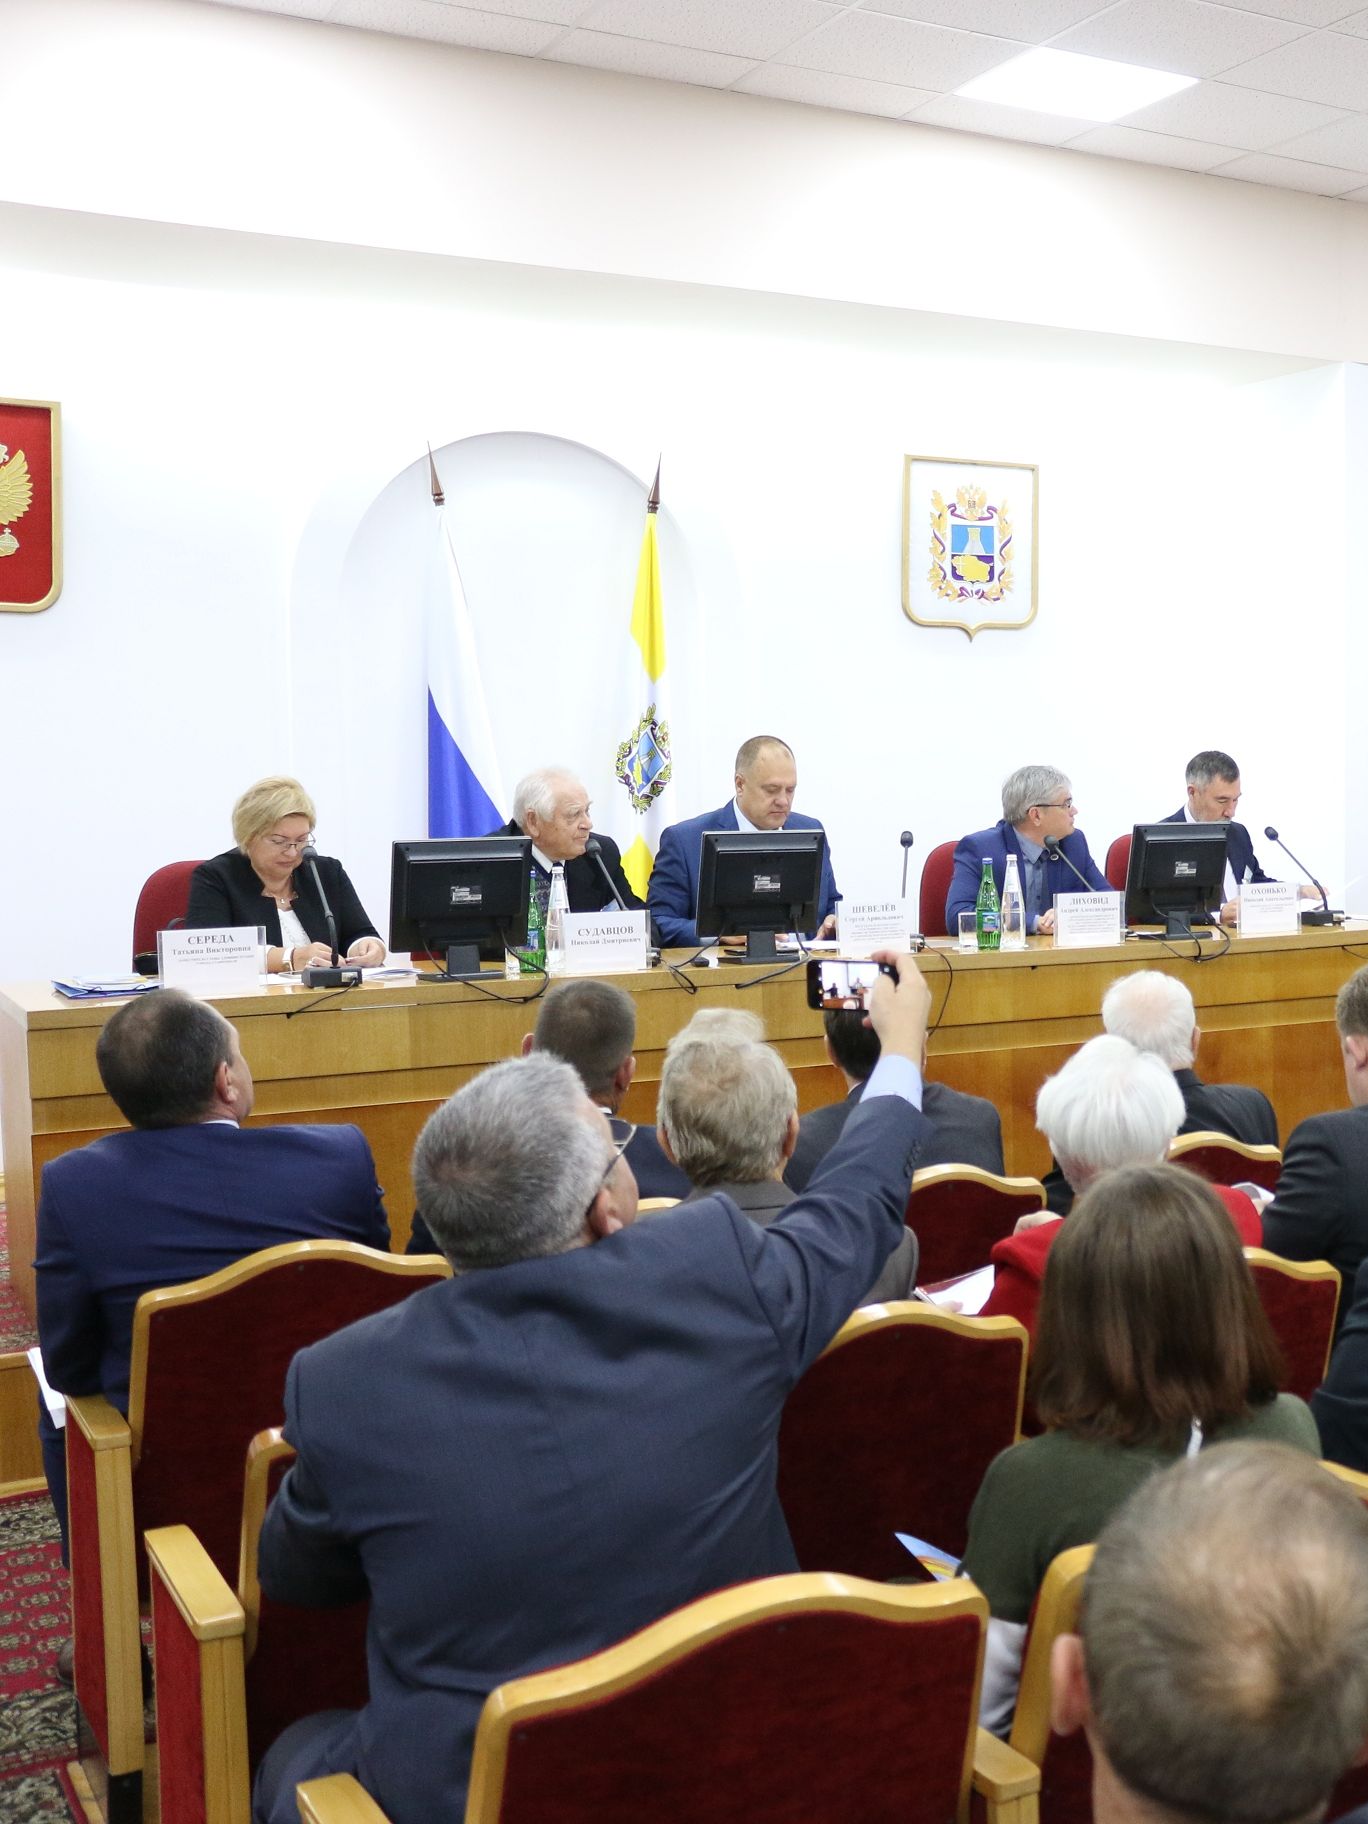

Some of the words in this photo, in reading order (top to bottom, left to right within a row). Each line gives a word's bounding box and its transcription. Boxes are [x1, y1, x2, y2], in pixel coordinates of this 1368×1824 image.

[1251, 887, 1287, 896] ОХОНЬКО
[1070, 896, 1109, 906] ЛИХОВИД
[852, 903, 896, 914] ШЕВЕЛЁВ
[577, 925, 634, 937] СУДАВЦОВ
[187, 934, 235, 945] СЕРЕДА
[602, 937, 641, 945] Дмитриевич
[172, 948, 204, 956] Татьяна
[206, 945, 251, 954] Викторовна
